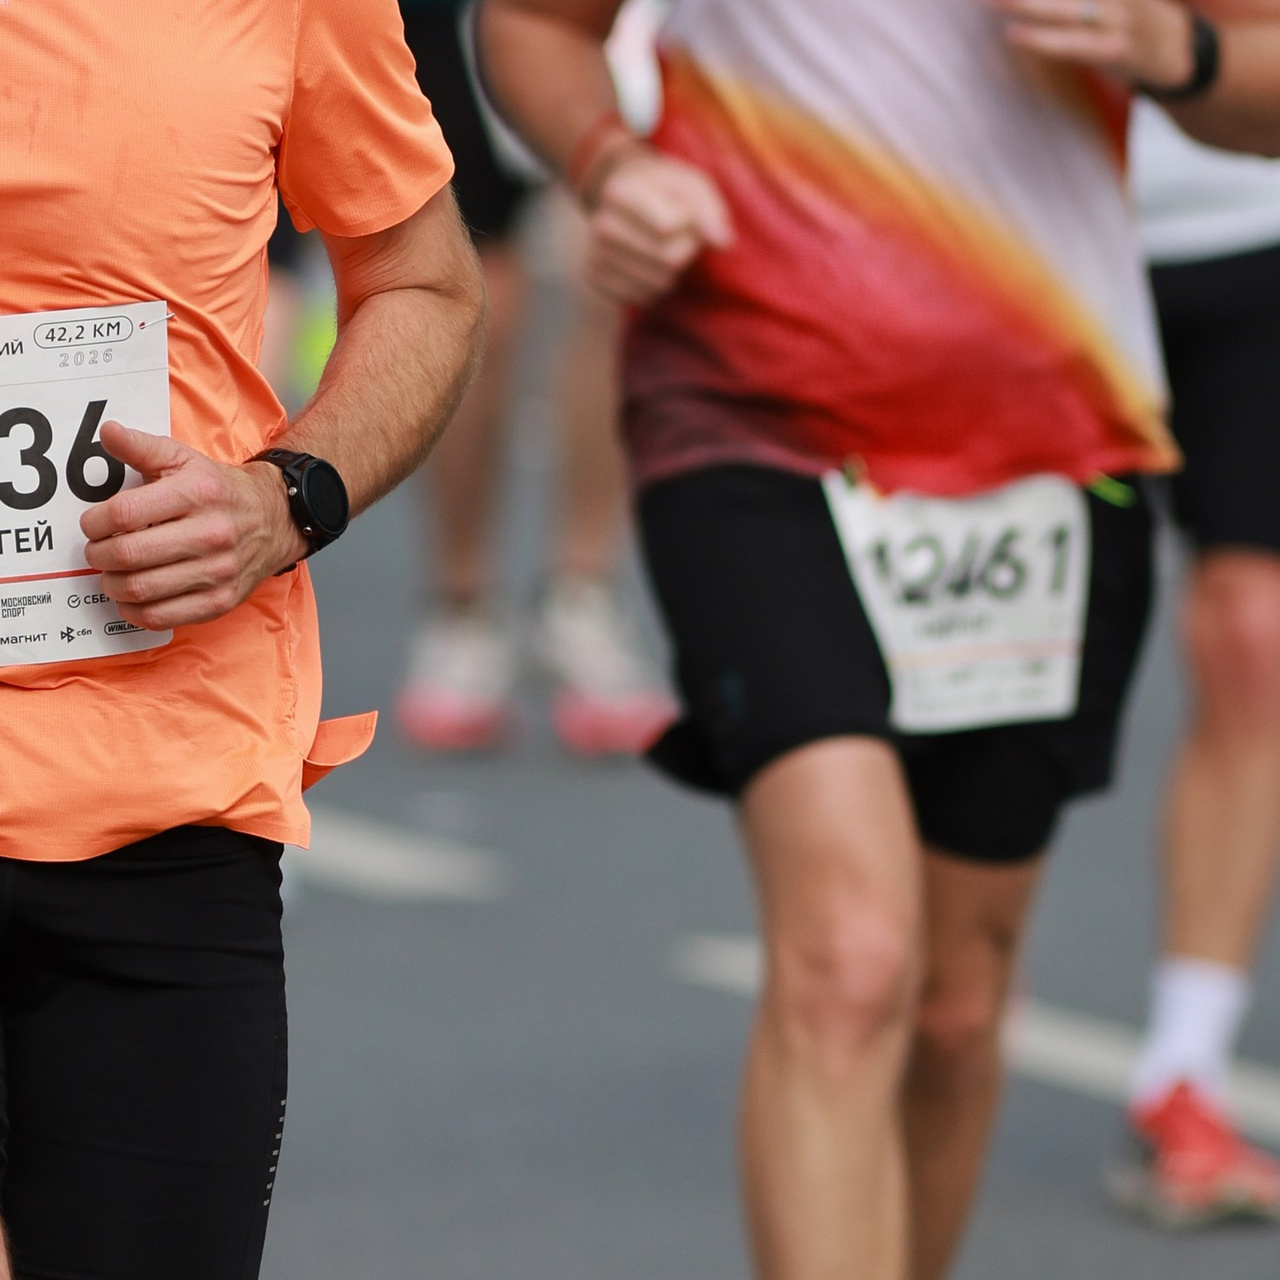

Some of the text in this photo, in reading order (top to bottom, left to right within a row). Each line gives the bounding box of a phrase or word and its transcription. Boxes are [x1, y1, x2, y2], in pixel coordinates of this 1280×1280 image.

[45, 321, 121, 343] 42,2 КМ
[59, 348, 114, 368] 2026
[0, 592, 52, 607] МОСКОВСКИЙ
[1, 606, 26, 619] СПОРТ
[76, 628, 92, 637] сбп
